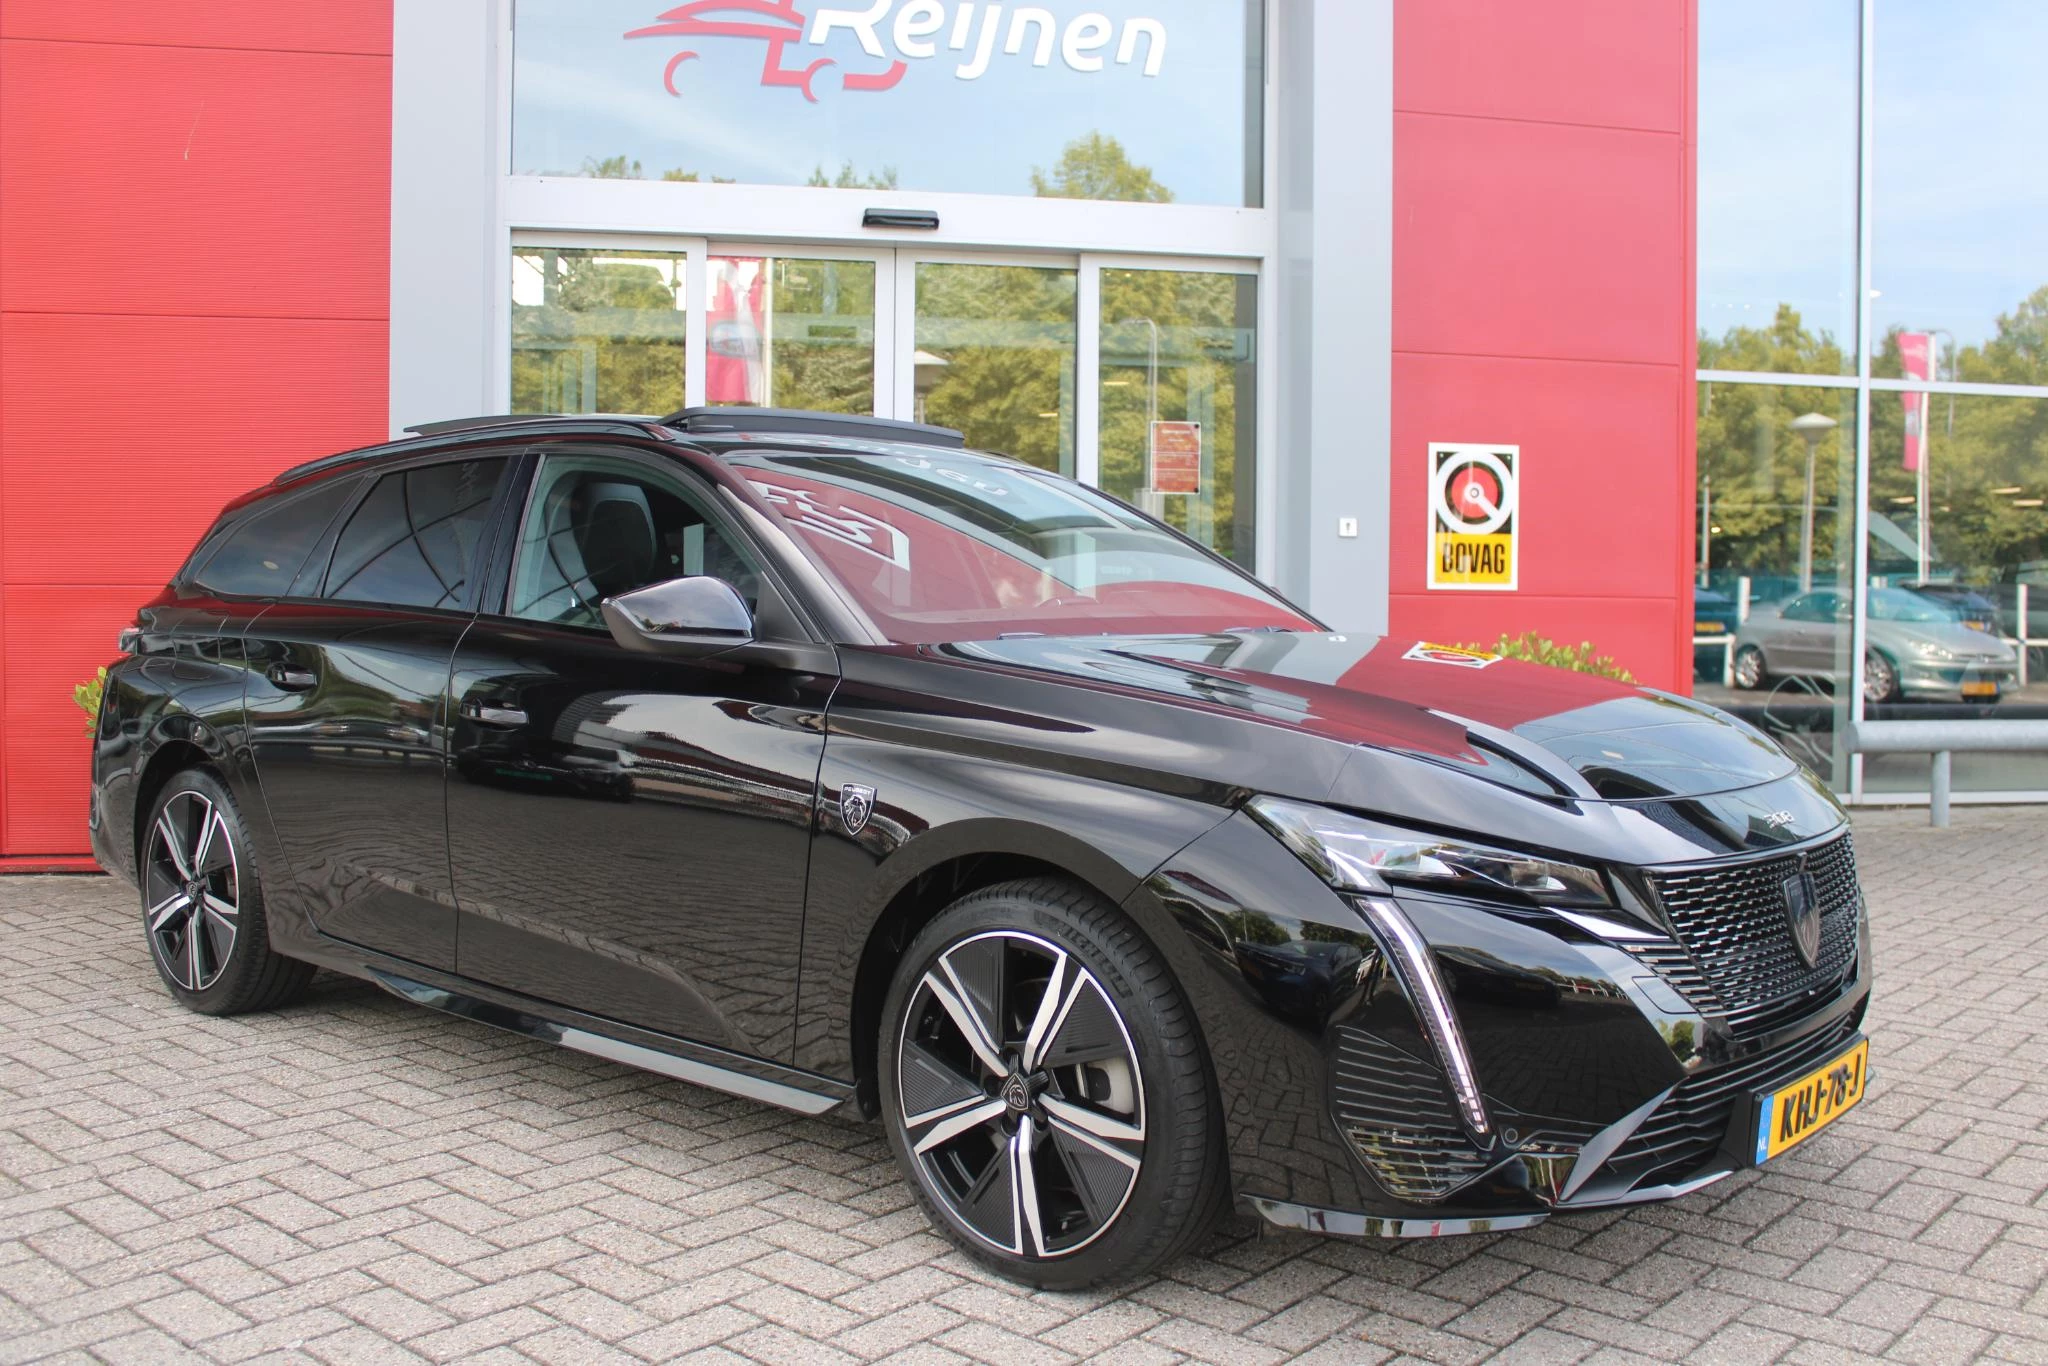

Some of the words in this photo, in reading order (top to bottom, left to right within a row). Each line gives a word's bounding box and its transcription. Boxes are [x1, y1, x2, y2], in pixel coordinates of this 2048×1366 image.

[808, 0, 1167, 80] Reijnen
[1442, 541, 1506, 575] BOVAG
[1779, 1053, 1862, 1143] KHJ-78-J
[1757, 1138, 1768, 1154] NL
